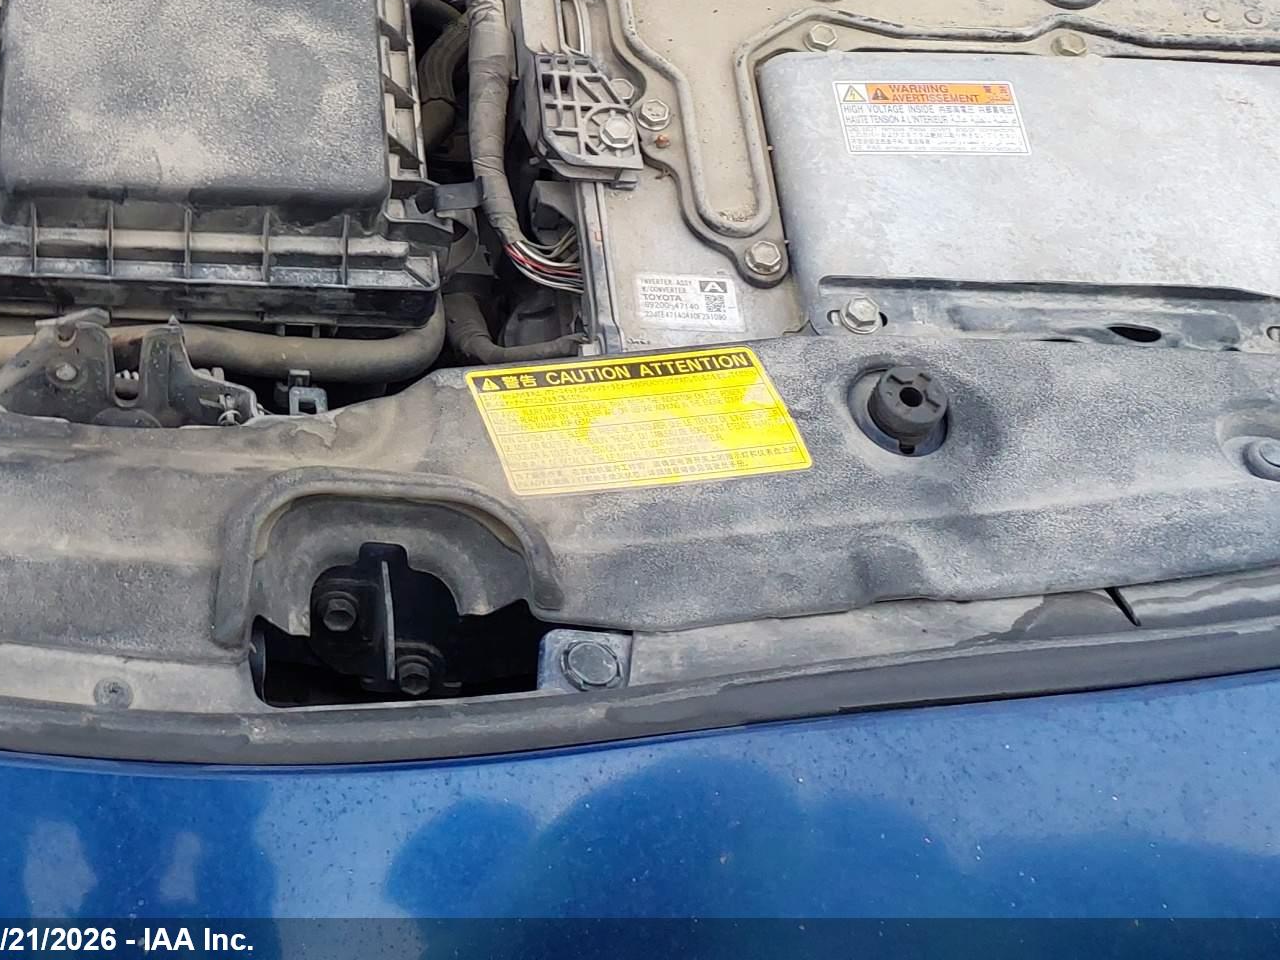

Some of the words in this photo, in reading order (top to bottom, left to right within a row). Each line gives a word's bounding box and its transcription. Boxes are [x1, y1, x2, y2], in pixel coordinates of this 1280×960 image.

[888, 84, 948, 93] WARNING
[891, 94, 980, 102] AVERTISSEMENT
[844, 105, 864, 113] HIGH
[866, 105, 905, 113] VOLTAGE
[908, 105, 935, 113] INSIDE
[546, 364, 631, 385] CAUTION
[639, 354, 749, 377] ATTENTION
[501, 374, 538, 389] 警告
